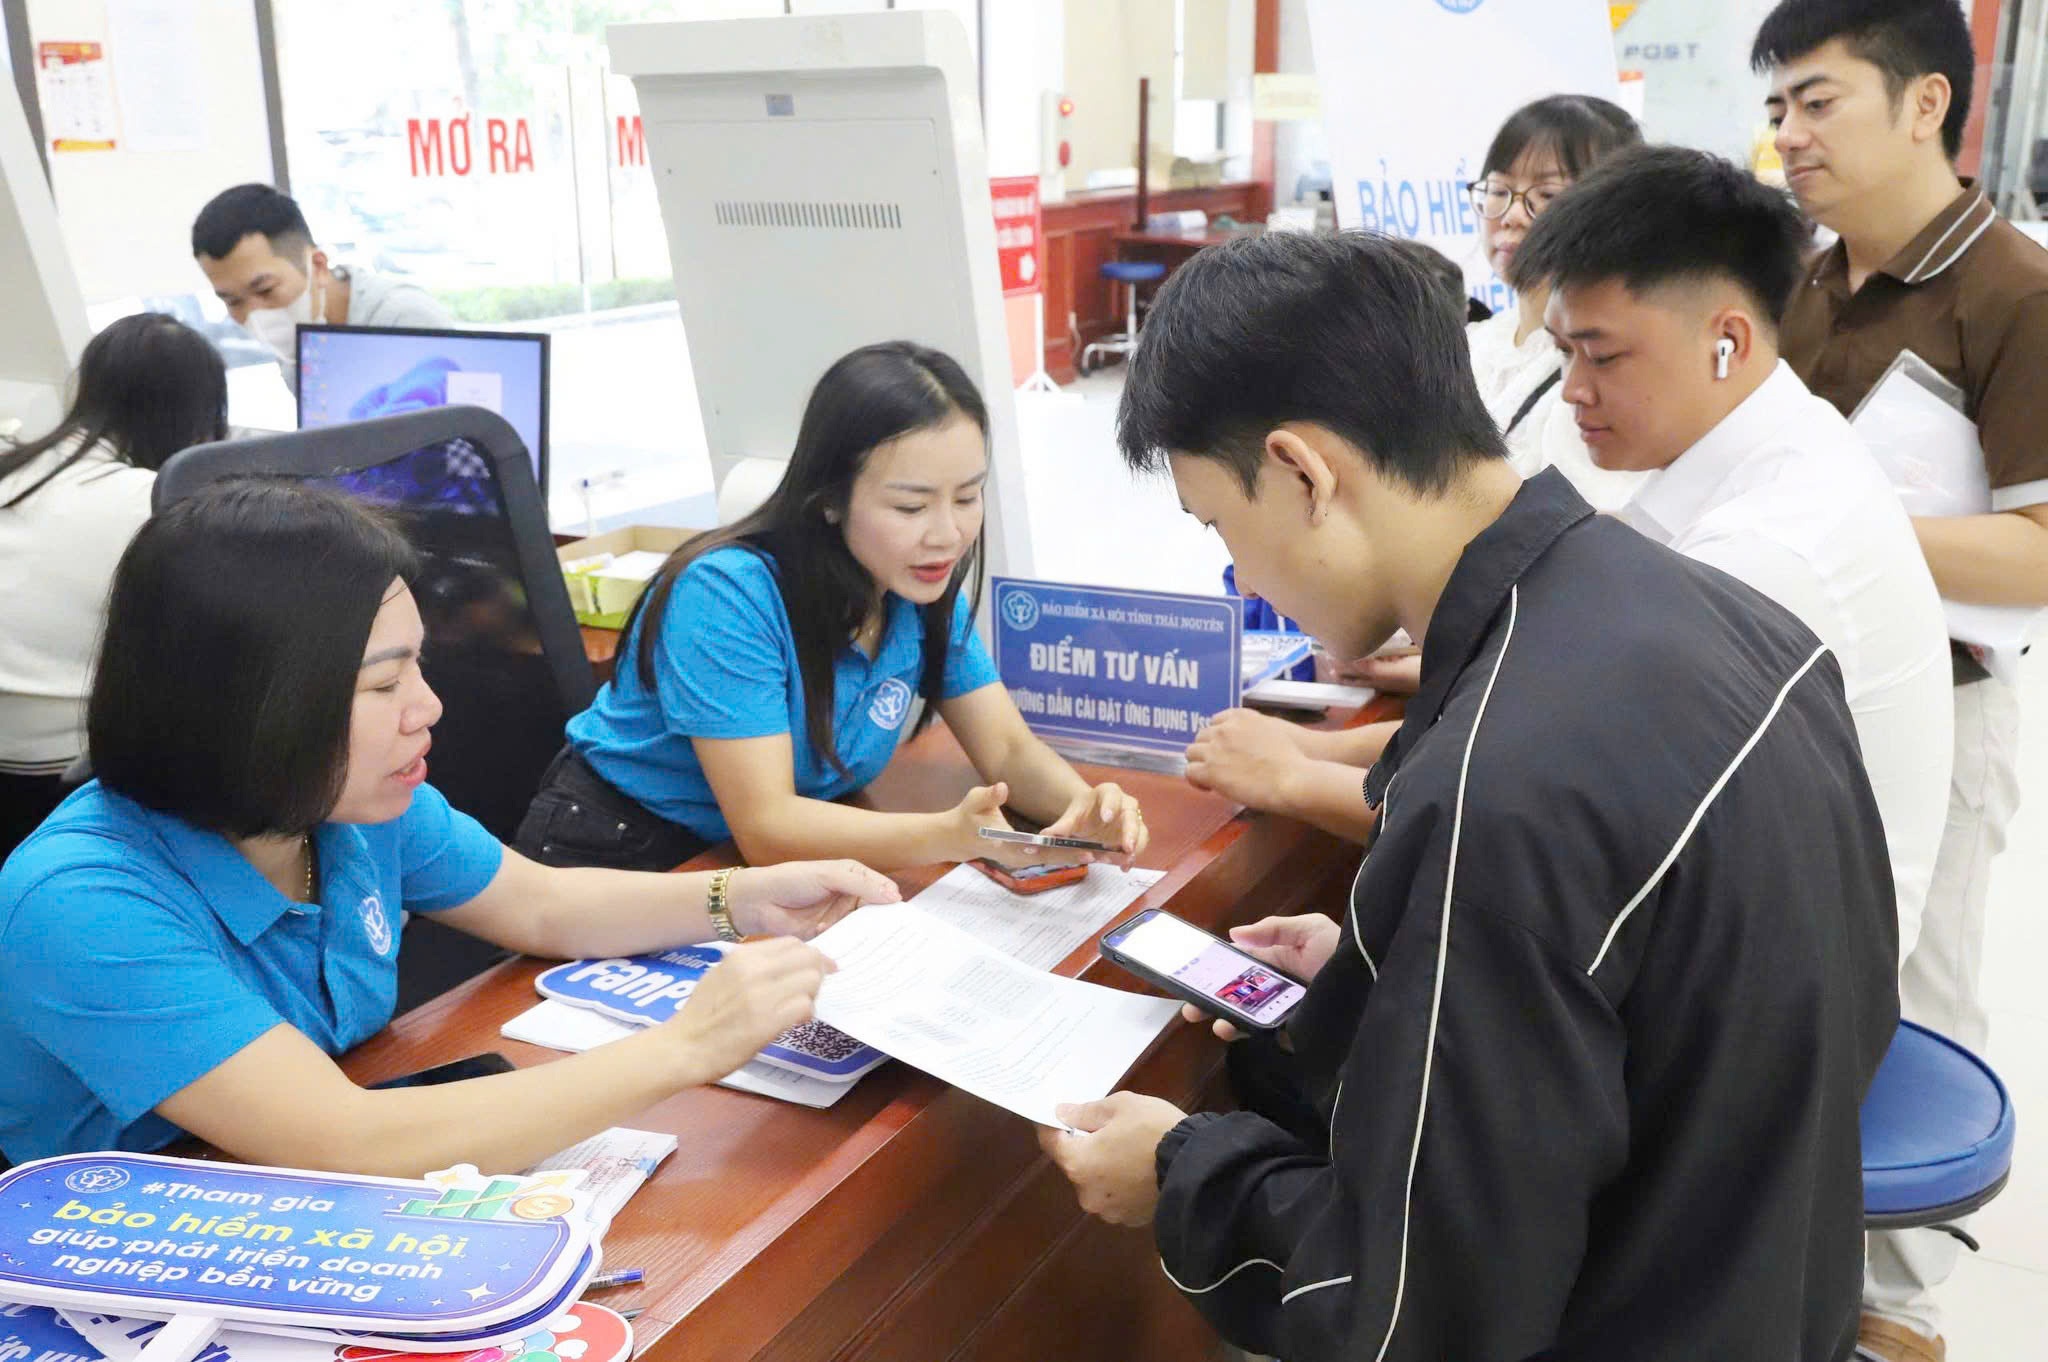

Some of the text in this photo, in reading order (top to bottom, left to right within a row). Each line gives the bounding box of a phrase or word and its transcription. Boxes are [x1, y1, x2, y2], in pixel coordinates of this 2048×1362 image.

[407, 96, 535, 177] MỞ RA
[617, 115, 645, 167] M
[1357, 157, 1481, 238] BẢO HIỂ
[1029, 635, 1199, 689] ĐIỂM TƯ VẤN
[1075, 693, 1096, 720] CÀI
[1098, 697, 1122, 727] ĐẶT
[1125, 699, 1150, 727] ỨNG
[1153, 706, 1188, 734] DỤNG
[566, 958, 697, 1010] Fanp
[140, 1181, 335, 1213] #Tham gia
[27, 1228, 443, 1280] giúp phát triển doanh
[53, 1200, 469, 1261] bảo hiểm xã hội
[51, 1254, 383, 1303] nghiệp bền vững
